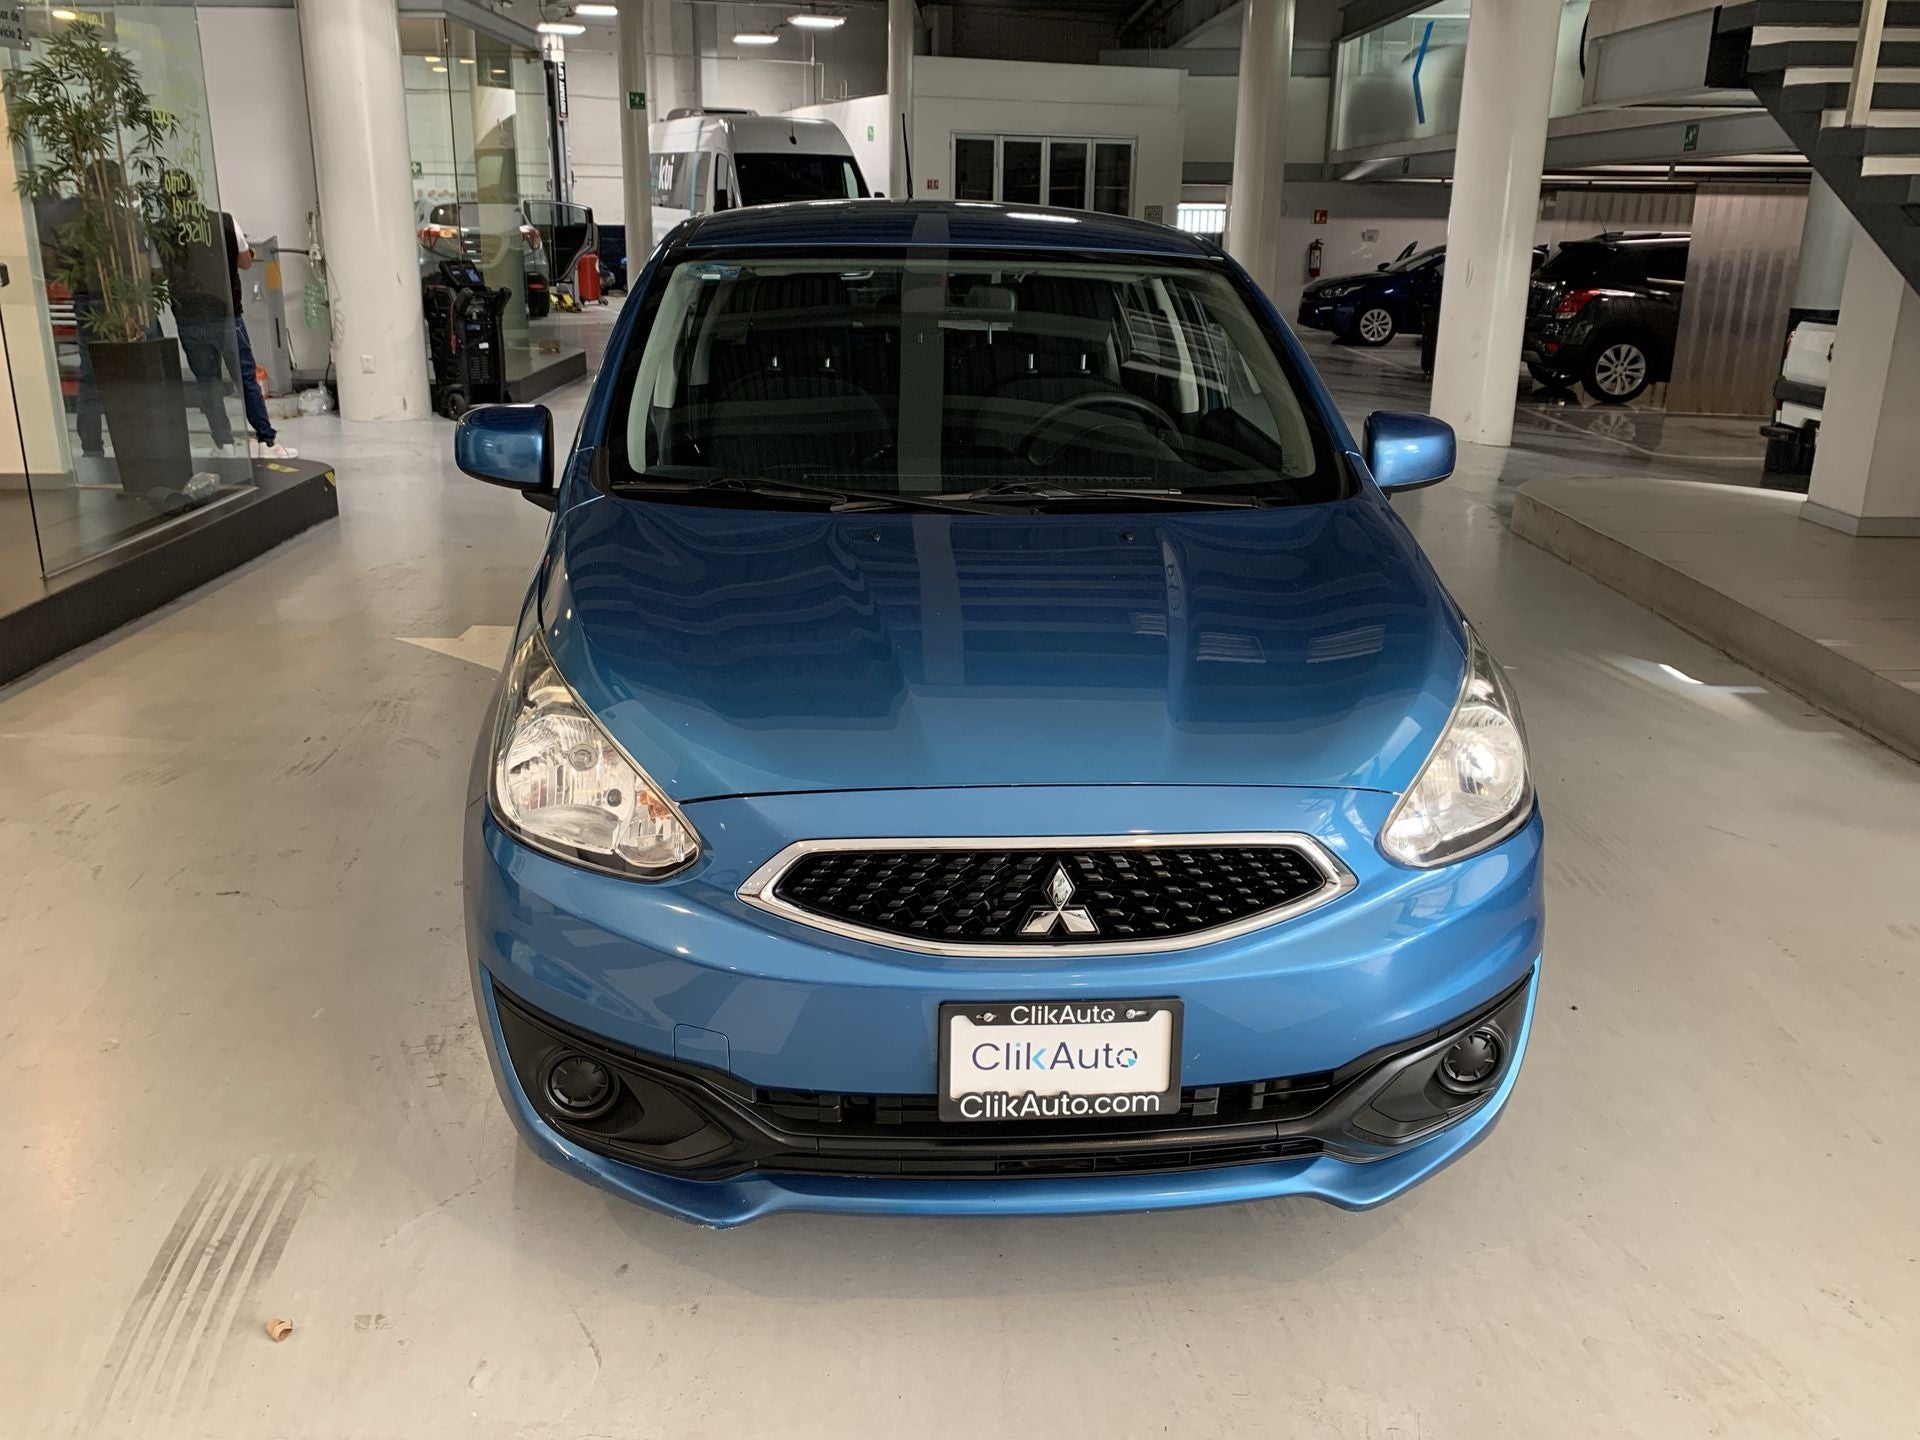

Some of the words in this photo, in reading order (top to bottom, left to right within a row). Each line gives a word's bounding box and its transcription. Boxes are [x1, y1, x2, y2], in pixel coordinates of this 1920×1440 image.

[10, 9, 20, 22] de
[17, 28, 23, 40] 2
[1010, 1005, 1116, 1025] ClikAuto
[972, 1041, 1138, 1071] ClikAuto
[960, 1094, 1160, 1118] ClikAuto.com
